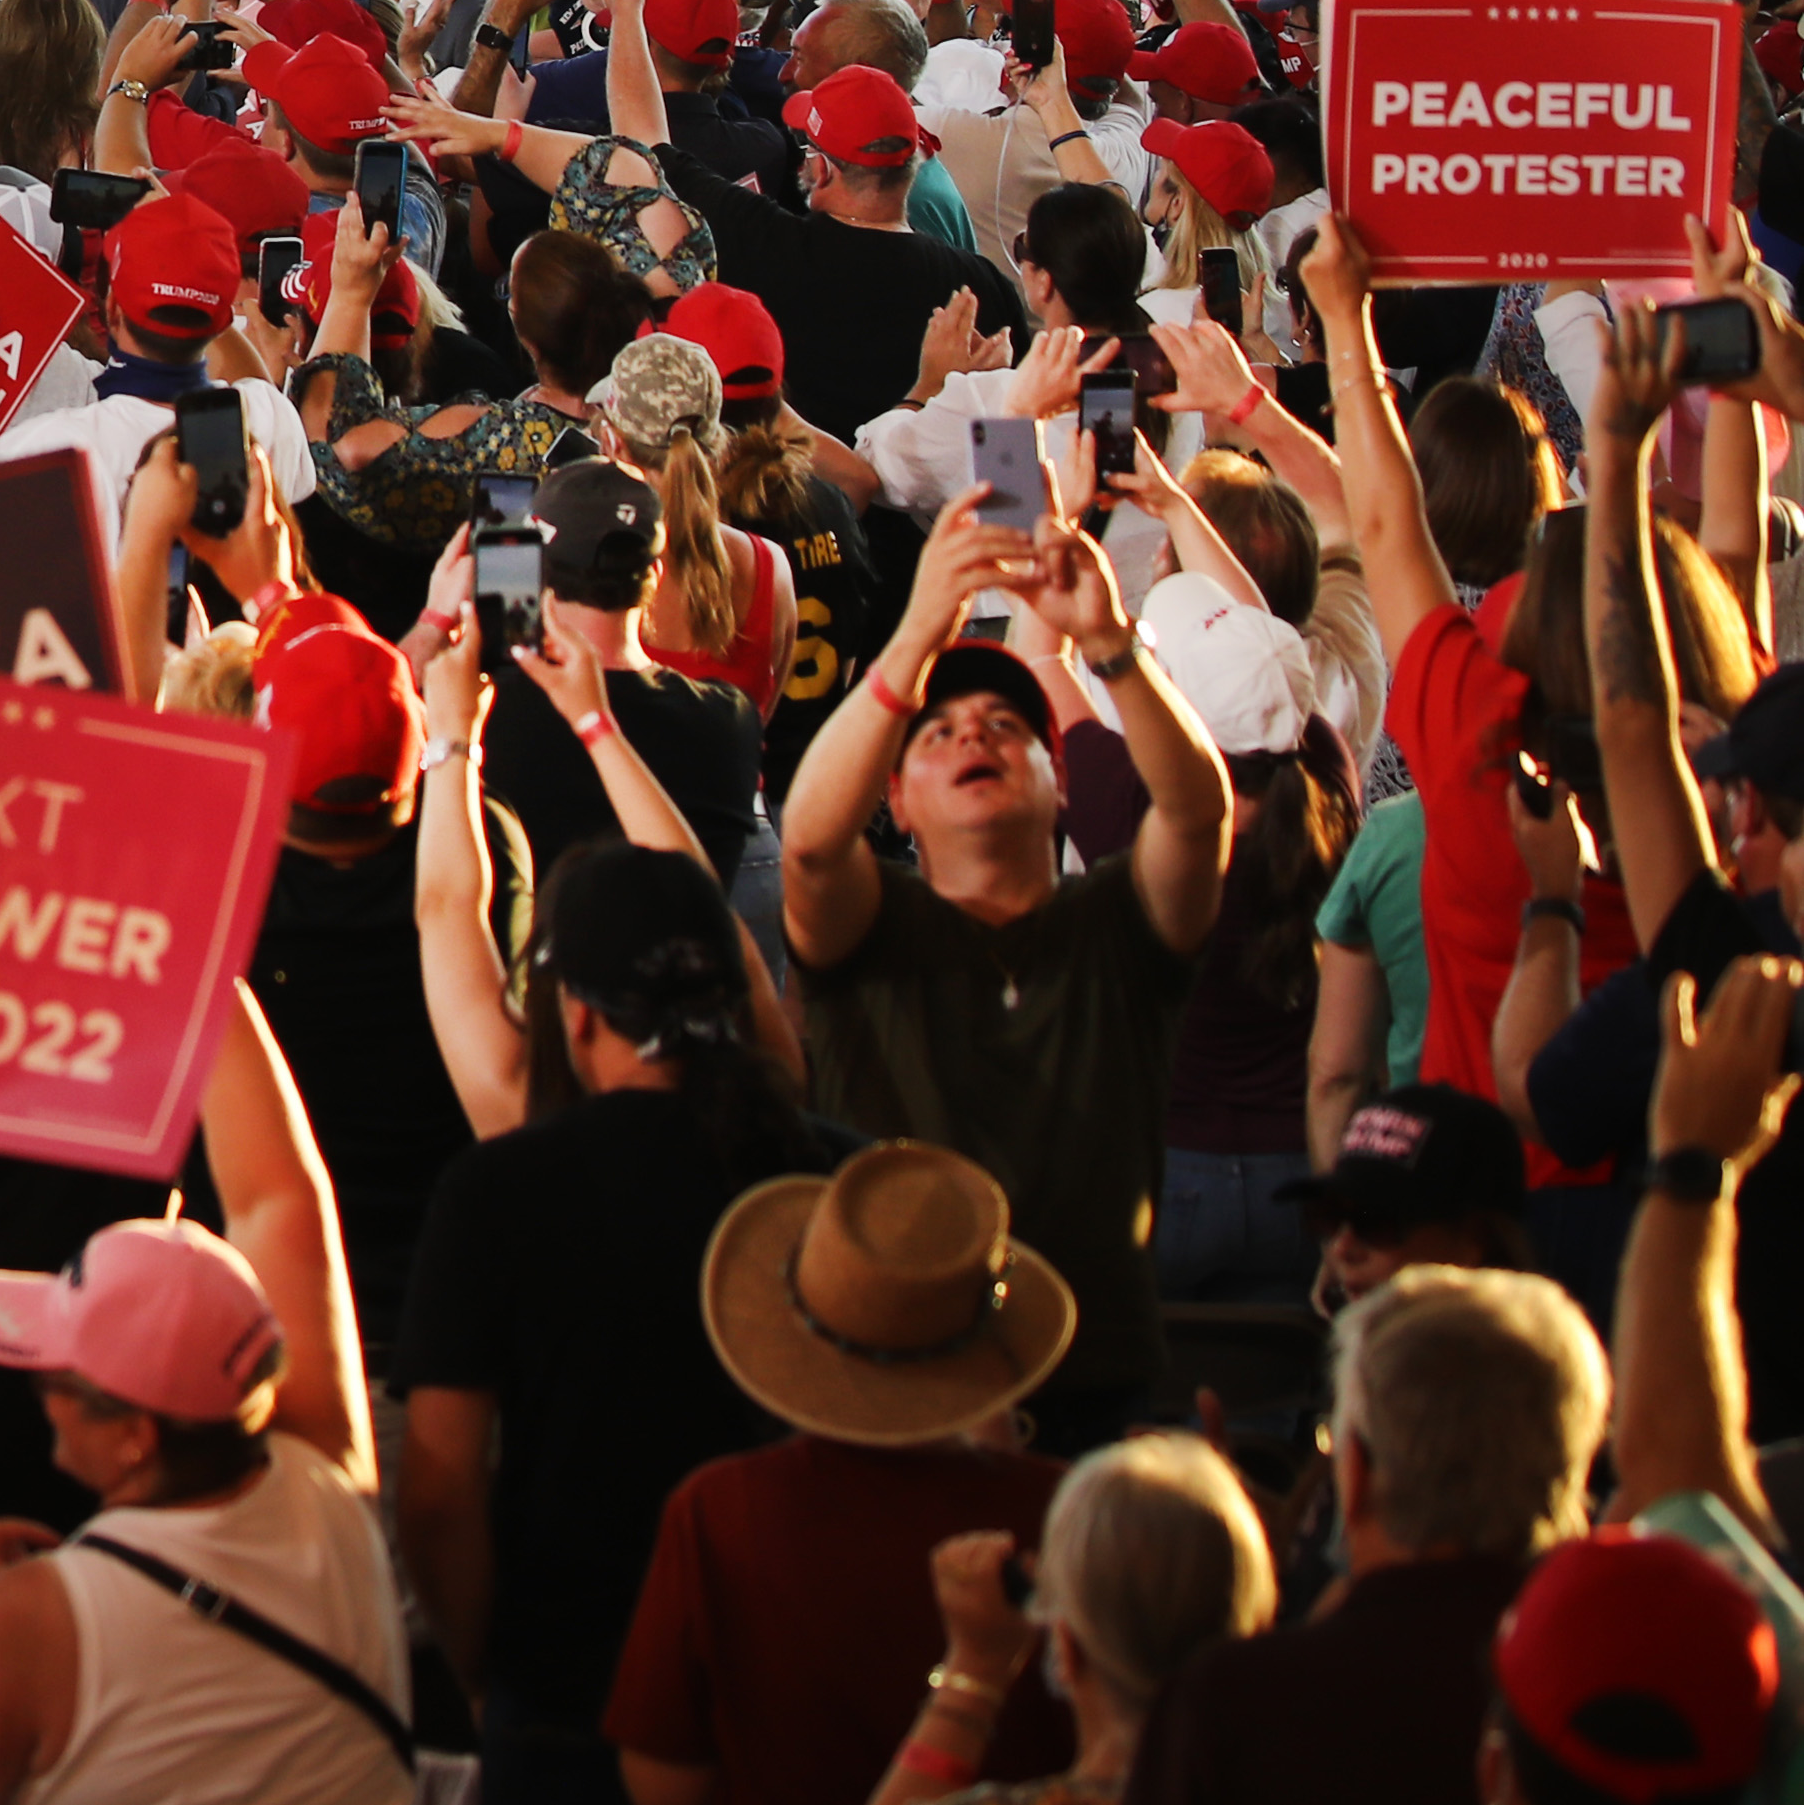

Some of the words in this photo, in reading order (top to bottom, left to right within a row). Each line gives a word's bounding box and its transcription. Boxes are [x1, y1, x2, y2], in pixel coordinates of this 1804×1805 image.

[1371, 81, 1692, 132] PEACEFUL
[1371, 153, 1685, 196] PROTESTER
[1497, 251, 1549, 268] 2020
